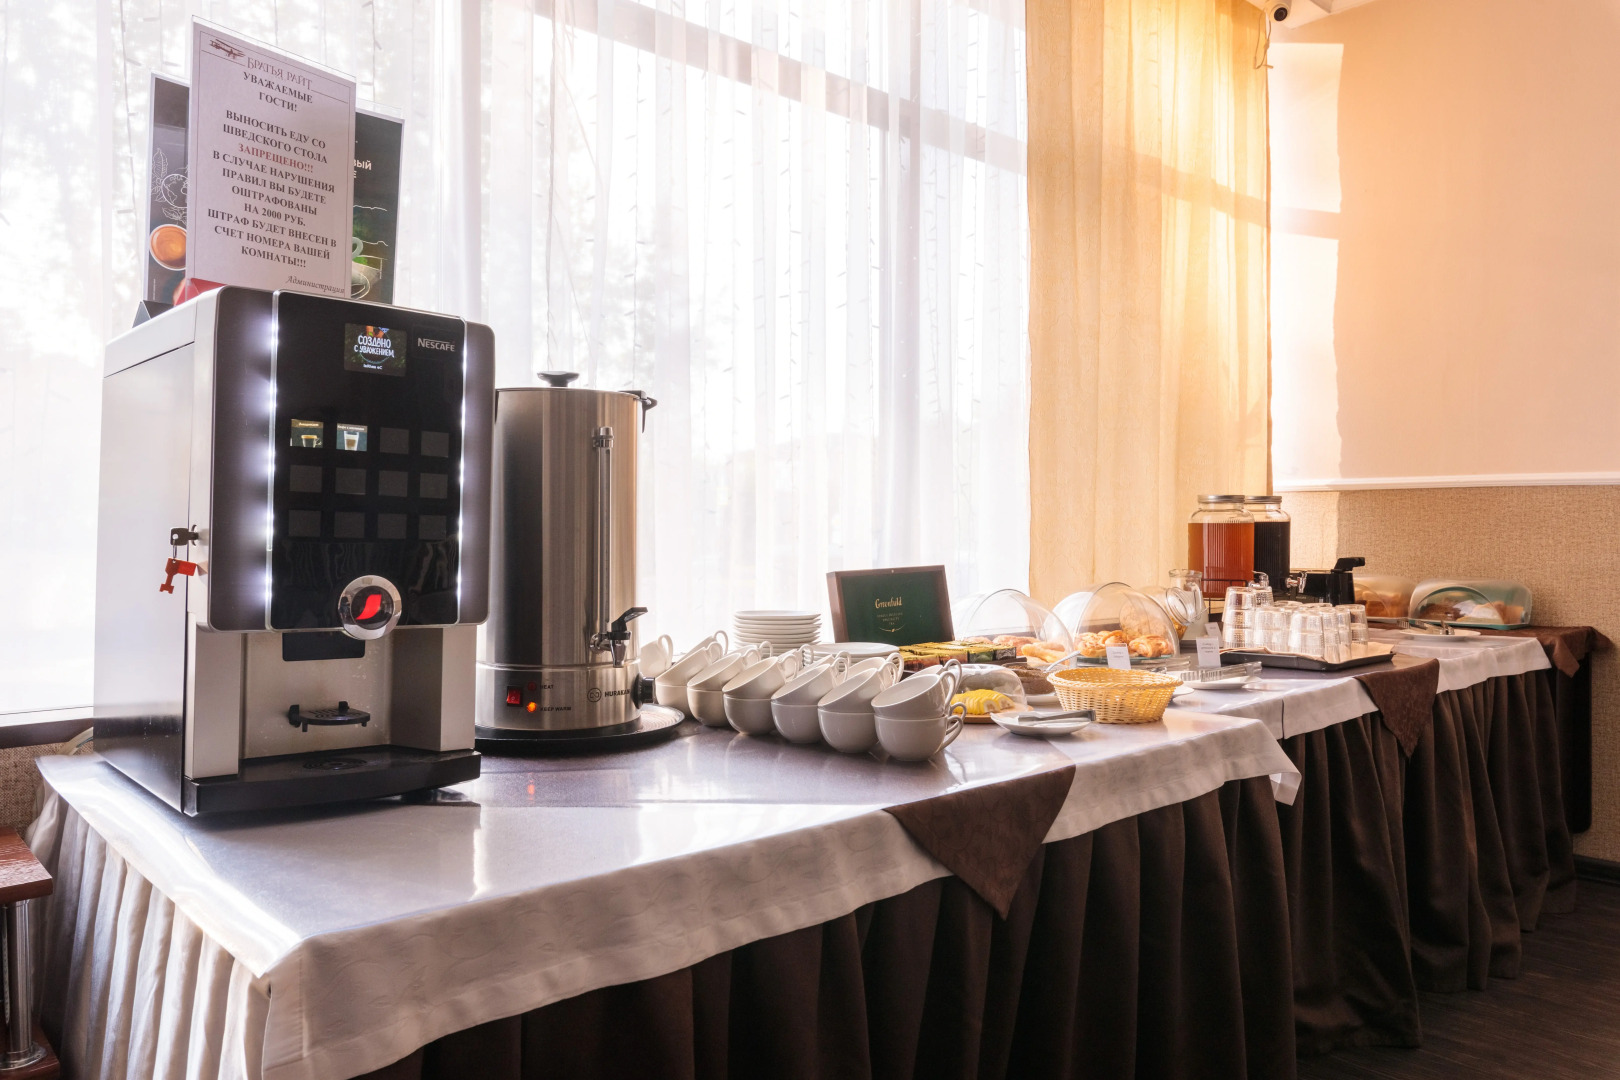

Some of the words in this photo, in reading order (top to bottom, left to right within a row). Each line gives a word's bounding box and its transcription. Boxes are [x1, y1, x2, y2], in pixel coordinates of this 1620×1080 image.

[247, 57, 283, 80] БРАТЬЯ
[243, 71, 313, 103] УВАЖАЕМЫЕ
[259, 91, 297, 112] ГОСТИ!
[223, 124, 291, 152] ШВЕДСКОГО
[293, 146, 328, 164] СТОЛА
[226, 110, 282, 137] ВЫНОСИТЬ
[290, 131, 309, 144] ЕДУ
[311, 139, 326, 149] СО
[213, 150, 220, 160] В
[222, 153, 267, 174] СЛУЧАЕ
[270, 167, 335, 193] НАРУШЕНИЯ
[238, 143, 313, 173] ЗАПРЕЩЕНО!!!
[222, 168, 267, 188] ПРАВИЛ
[269, 181, 285, 193] ВЫ
[288, 186, 326, 205] БУДЕТЕ
[231, 185, 317, 216] ОШТРАФОВАНЫ
[207, 208, 249, 226] ШТРАФ
[252, 219, 286, 236] БУДЕТ
[288, 228, 328, 246] ВНЕСЕН
[330, 238, 337, 248] В
[244, 203, 259, 215] НА
[261, 207, 282, 220] 2000
[284, 213, 306, 227] РУБ.
[214, 225, 243, 240] СЧЕТ
[247, 232, 291, 251] НОМЕРА
[293, 243, 330, 260] ВАШЕЙ
[241, 245, 307, 268] КОМНАТЫ!!!
[285, 275, 345, 293] Администрация
[353, 344, 359, 352] С
[359, 345, 395, 358] УВАЖЕНИЕМ
[357, 335, 392, 349] СОЗДАНО
